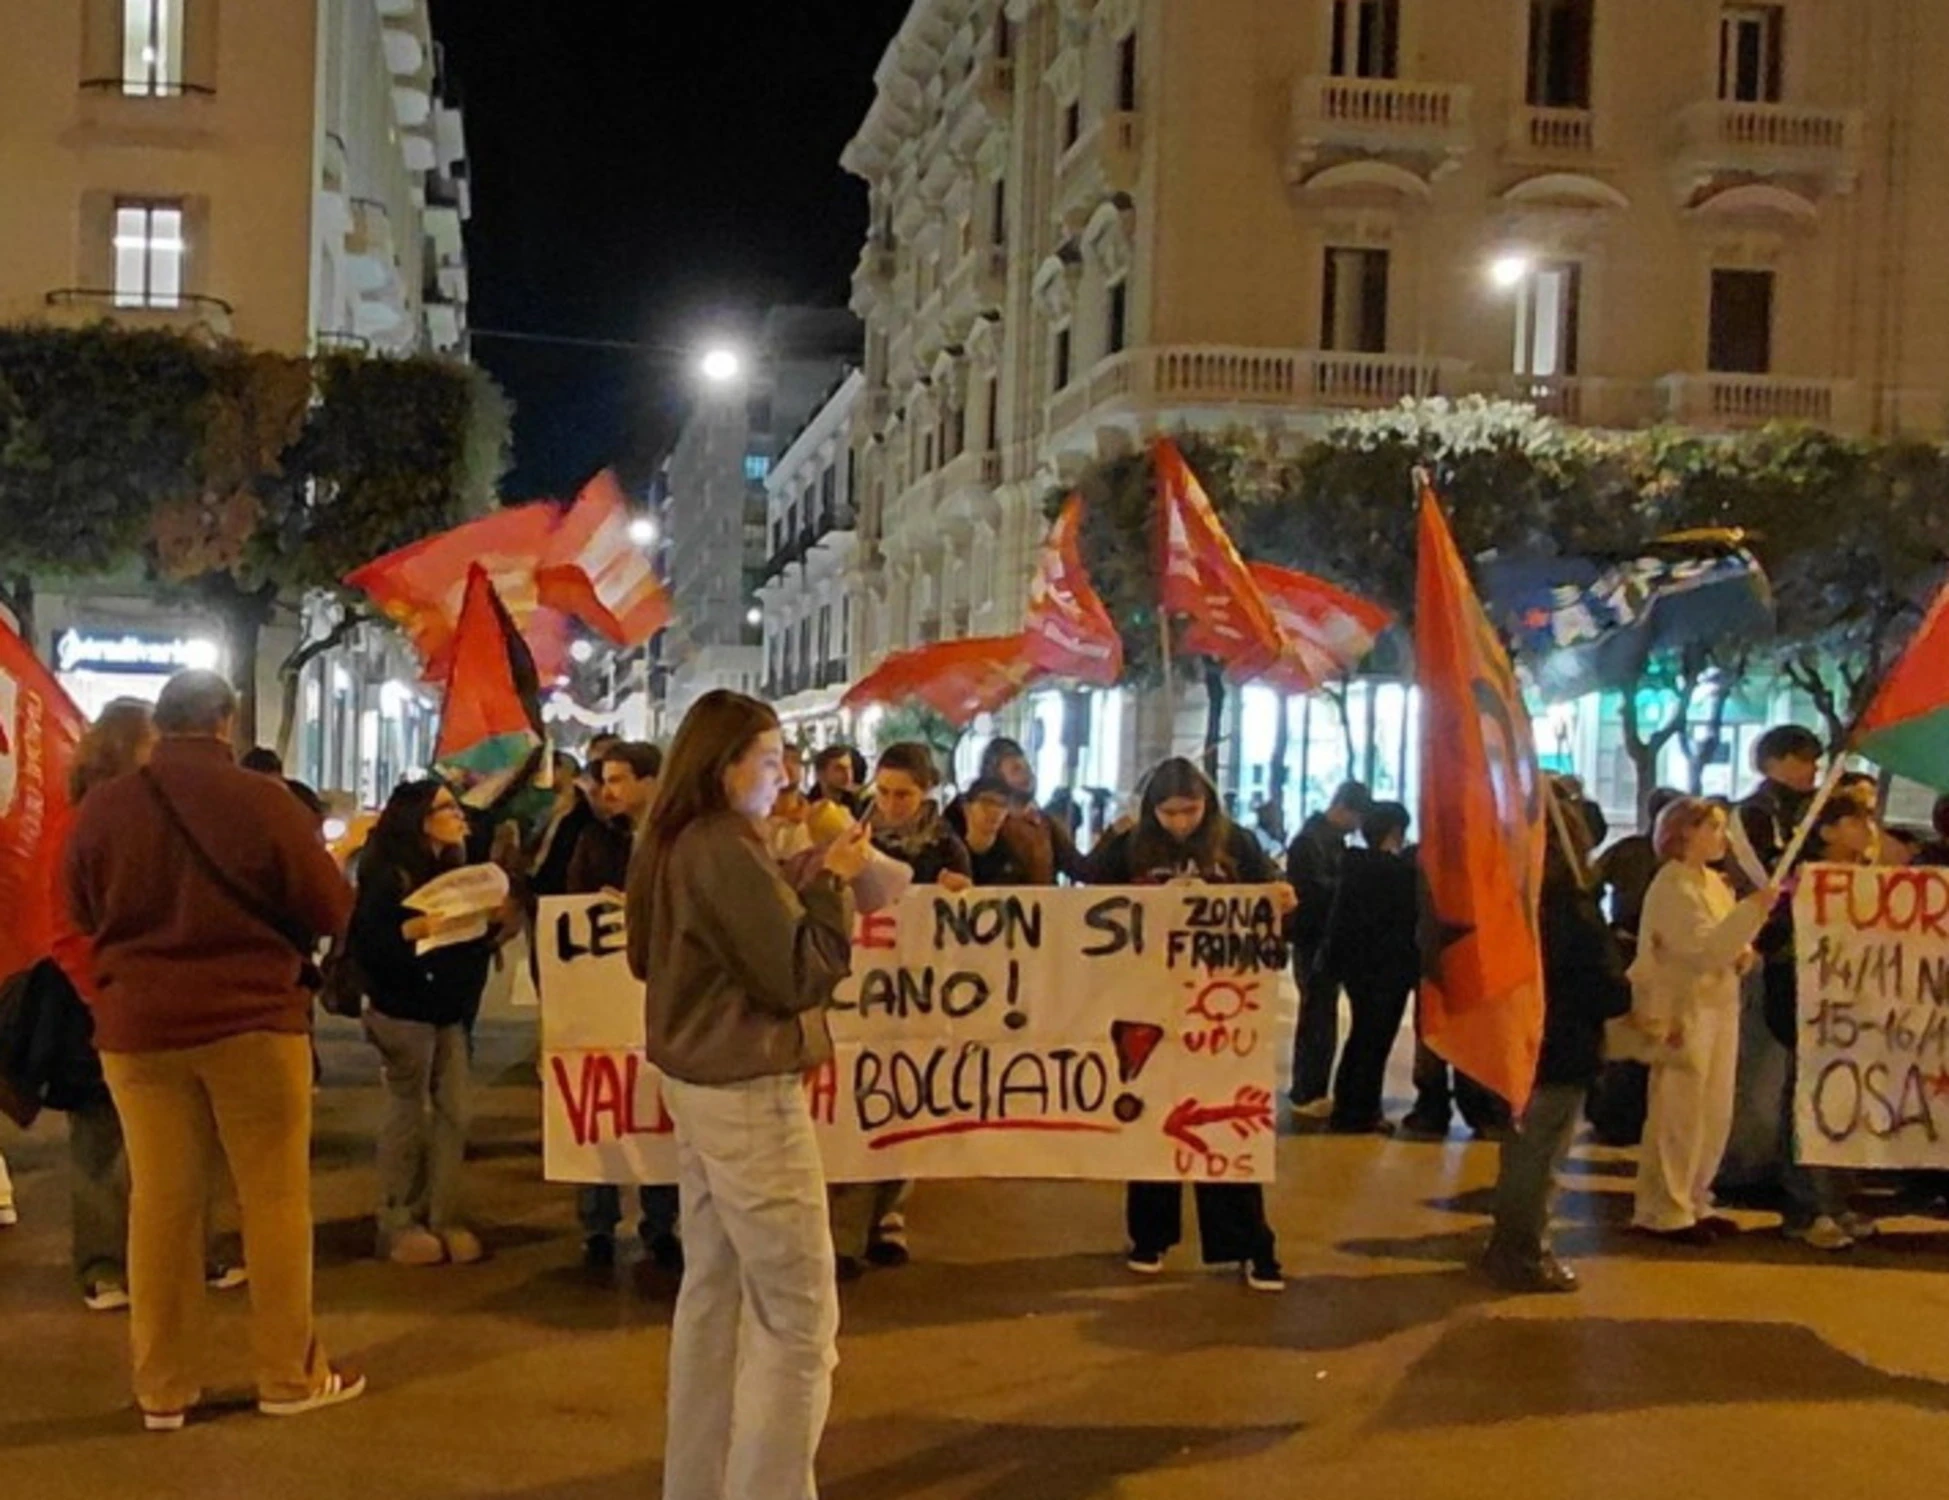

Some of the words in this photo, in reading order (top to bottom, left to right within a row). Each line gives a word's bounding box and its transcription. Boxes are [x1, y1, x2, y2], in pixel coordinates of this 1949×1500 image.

[932, 895, 1041, 949] NON
[1081, 896, 1145, 955] SI
[1181, 895, 1277, 936] ZONA
[1812, 1057, 1939, 1143] OSA
[1174, 1148, 1256, 1177] UDS
